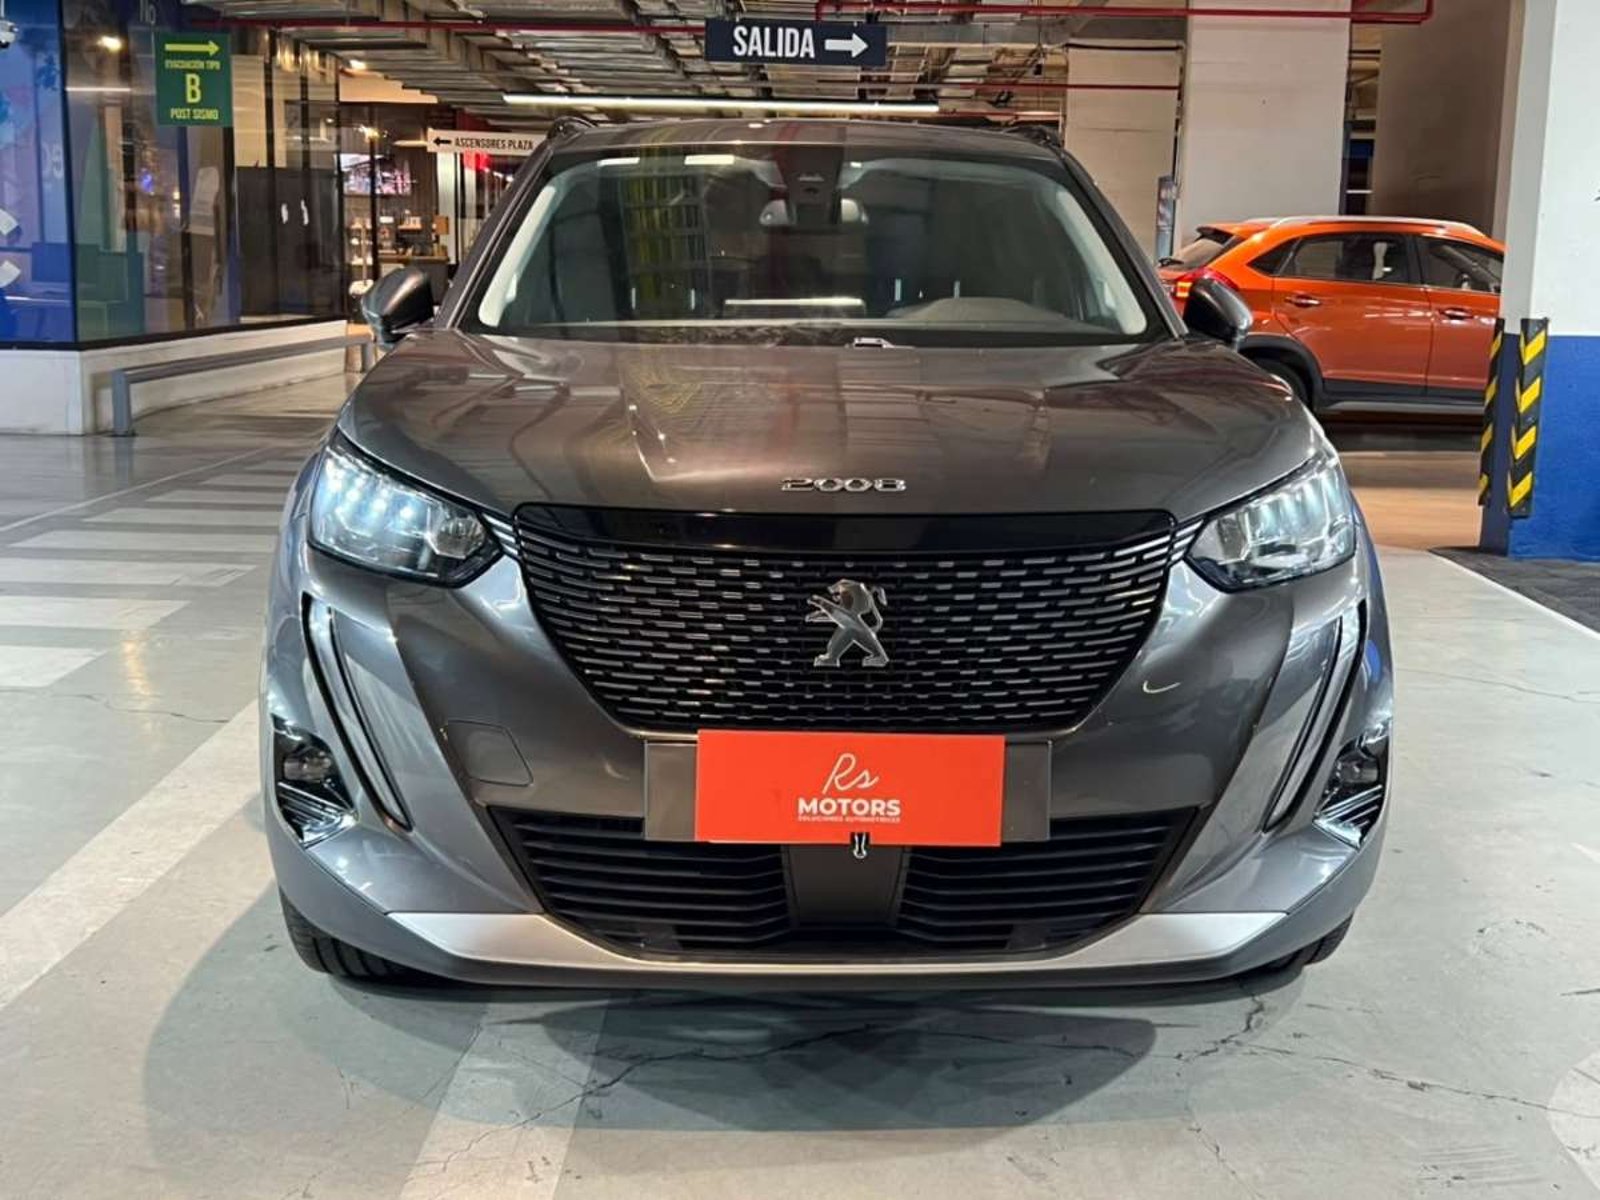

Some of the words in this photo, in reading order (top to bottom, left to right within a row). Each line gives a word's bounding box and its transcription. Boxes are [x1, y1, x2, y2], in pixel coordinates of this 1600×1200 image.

[733, 25, 815, 58] SALIDA
[185, 73, 201, 103] B
[170, 107, 190, 119] POST
[192, 108, 219, 120] SISMO
[455, 137, 506, 149] ASCENSORES
[508, 139, 533, 150] PLAZA
[780, 477, 907, 492] 2008
[821, 752, 880, 795] Rs
[798, 797, 901, 816] MOTORS
